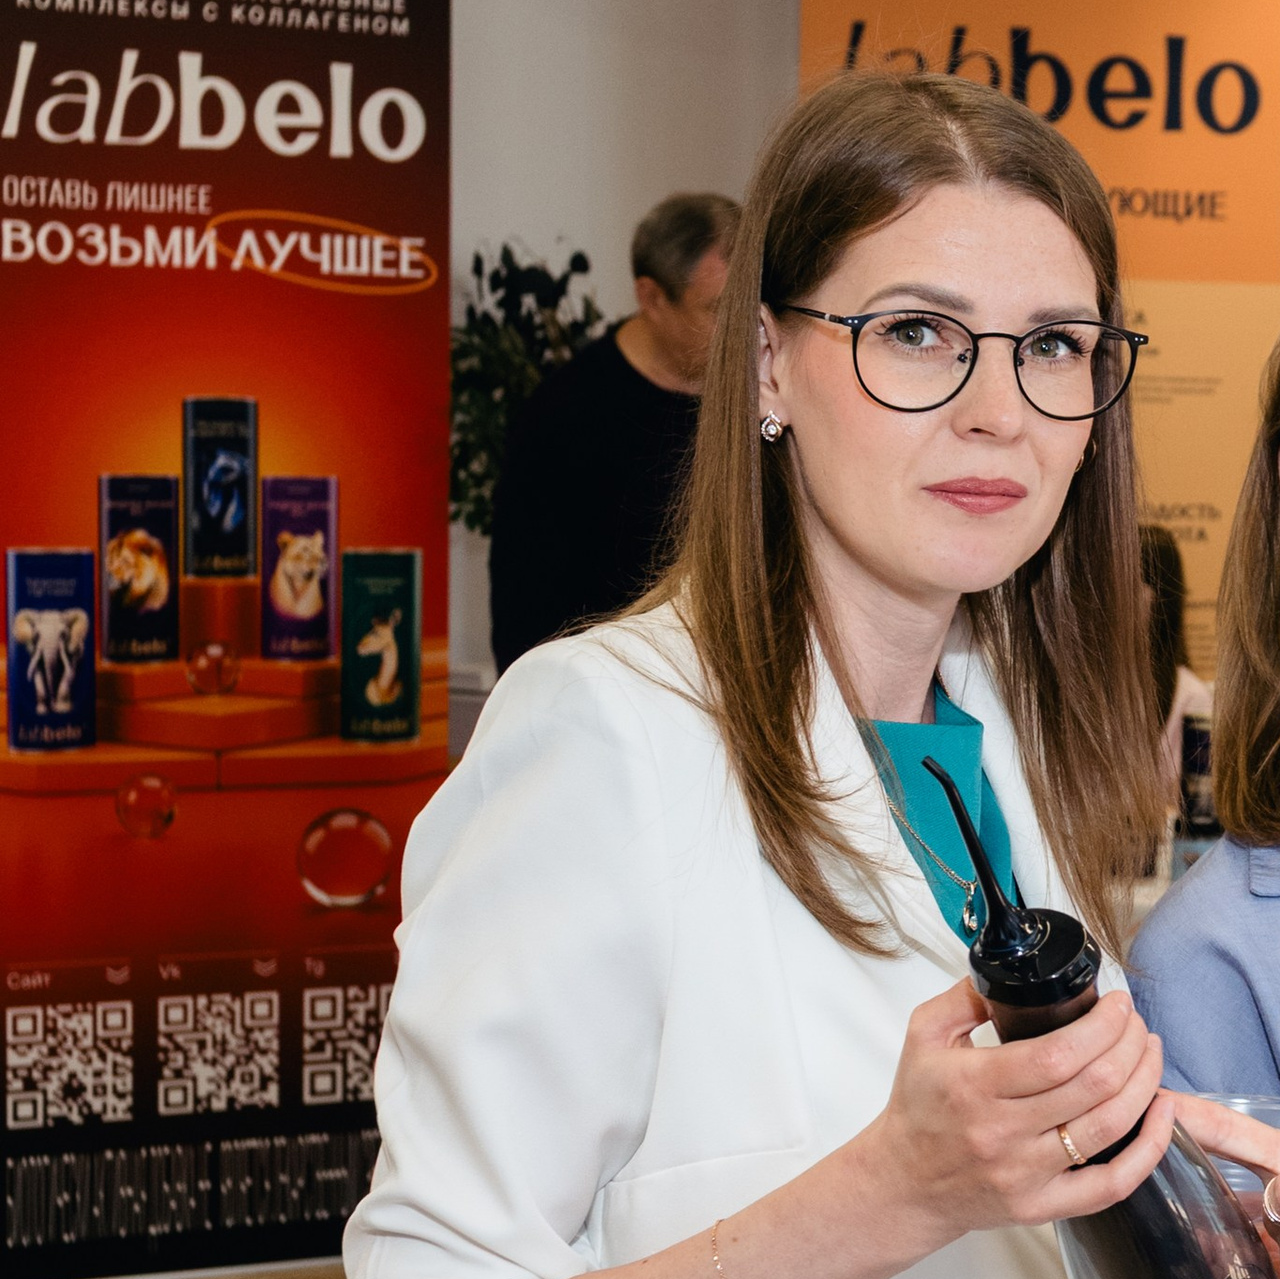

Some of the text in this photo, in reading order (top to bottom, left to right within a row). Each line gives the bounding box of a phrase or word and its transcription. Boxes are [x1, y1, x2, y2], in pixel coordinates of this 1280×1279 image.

[202, 1, 219, 22] С
[231, 5, 410, 37] КОЛЛАГЕНОМ
[1, 40, 427, 164] labbelo
[2, 174, 213, 215] ОСТАВЬ ЛИШНЕЕ
[1, 218, 426, 279] ВОЗЬМИ ЛУЧШЕЕ
